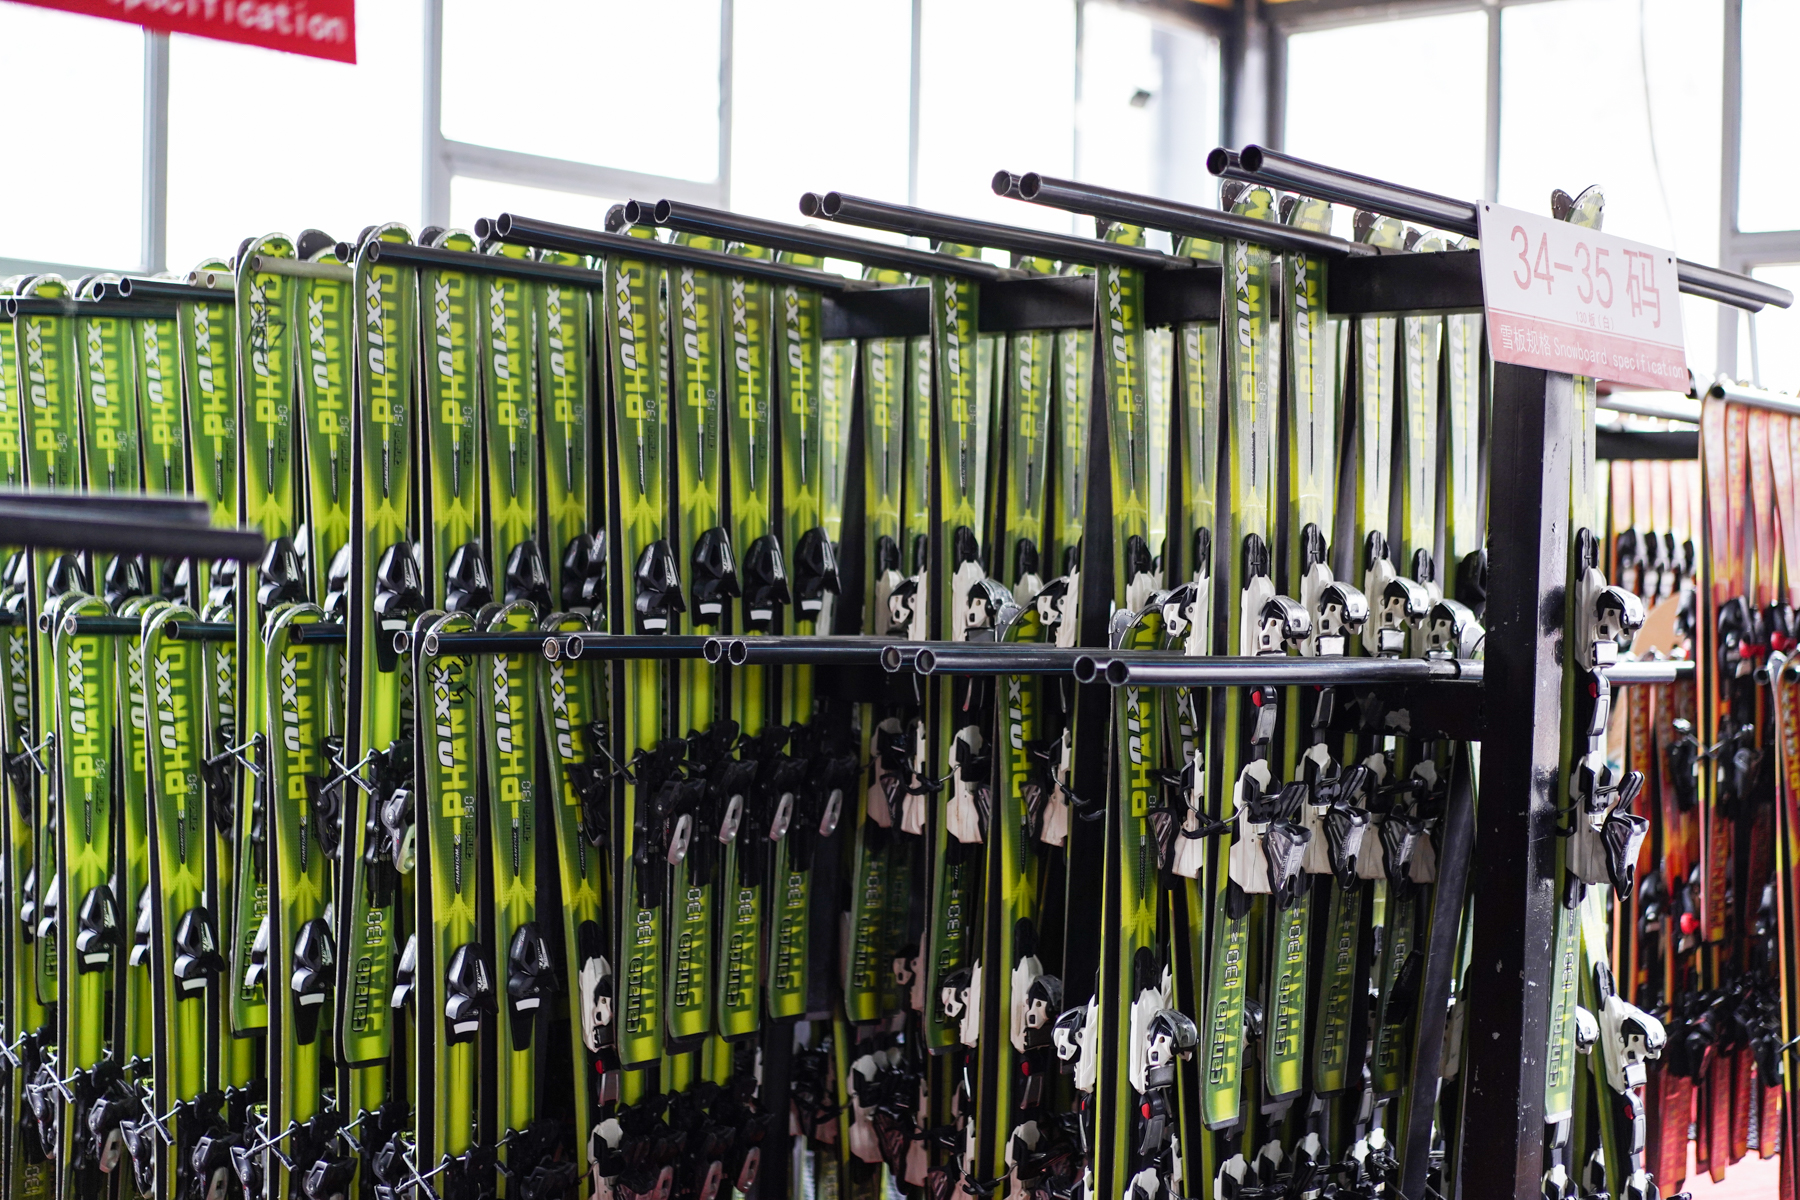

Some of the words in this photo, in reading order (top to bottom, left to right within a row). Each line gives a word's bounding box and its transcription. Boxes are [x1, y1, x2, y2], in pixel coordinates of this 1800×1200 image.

[1510, 225, 1614, 309] 34-35
[1622, 249, 1661, 329] 码
[371, 265, 399, 423] PHANTO
[440, 271, 466, 424] PHANTO
[495, 276, 522, 426] PHANTO
[621, 260, 650, 419] PHANTO
[1501, 324, 1551, 356] 雪板规格
[1553, 338, 1608, 366] Snowboard
[1613, 354, 1684, 380] specification
[1576, 311, 1588, 325] 130
[72, 637, 99, 778] PHANTO
[161, 636, 192, 795] PHANTO
[464, 796, 475, 818] 130
[521, 780, 532, 802] 130
[687, 888, 702, 921] 130
[738, 890, 752, 922] 130
[788, 875, 802, 906] 130
[366, 912, 382, 945] 130
[637, 911, 652, 945] 130
[1287, 924, 1302, 961] 130
[353, 956, 371, 1032] canada
[626, 957, 642, 1033] canada
[676, 933, 692, 1006] canada
[727, 934, 742, 1006] canada
[1224, 949, 1240, 987] 130
[1562, 952, 1574, 989] 130
[1210, 1001, 1228, 1084] canada
[1275, 974, 1291, 1056] canada
